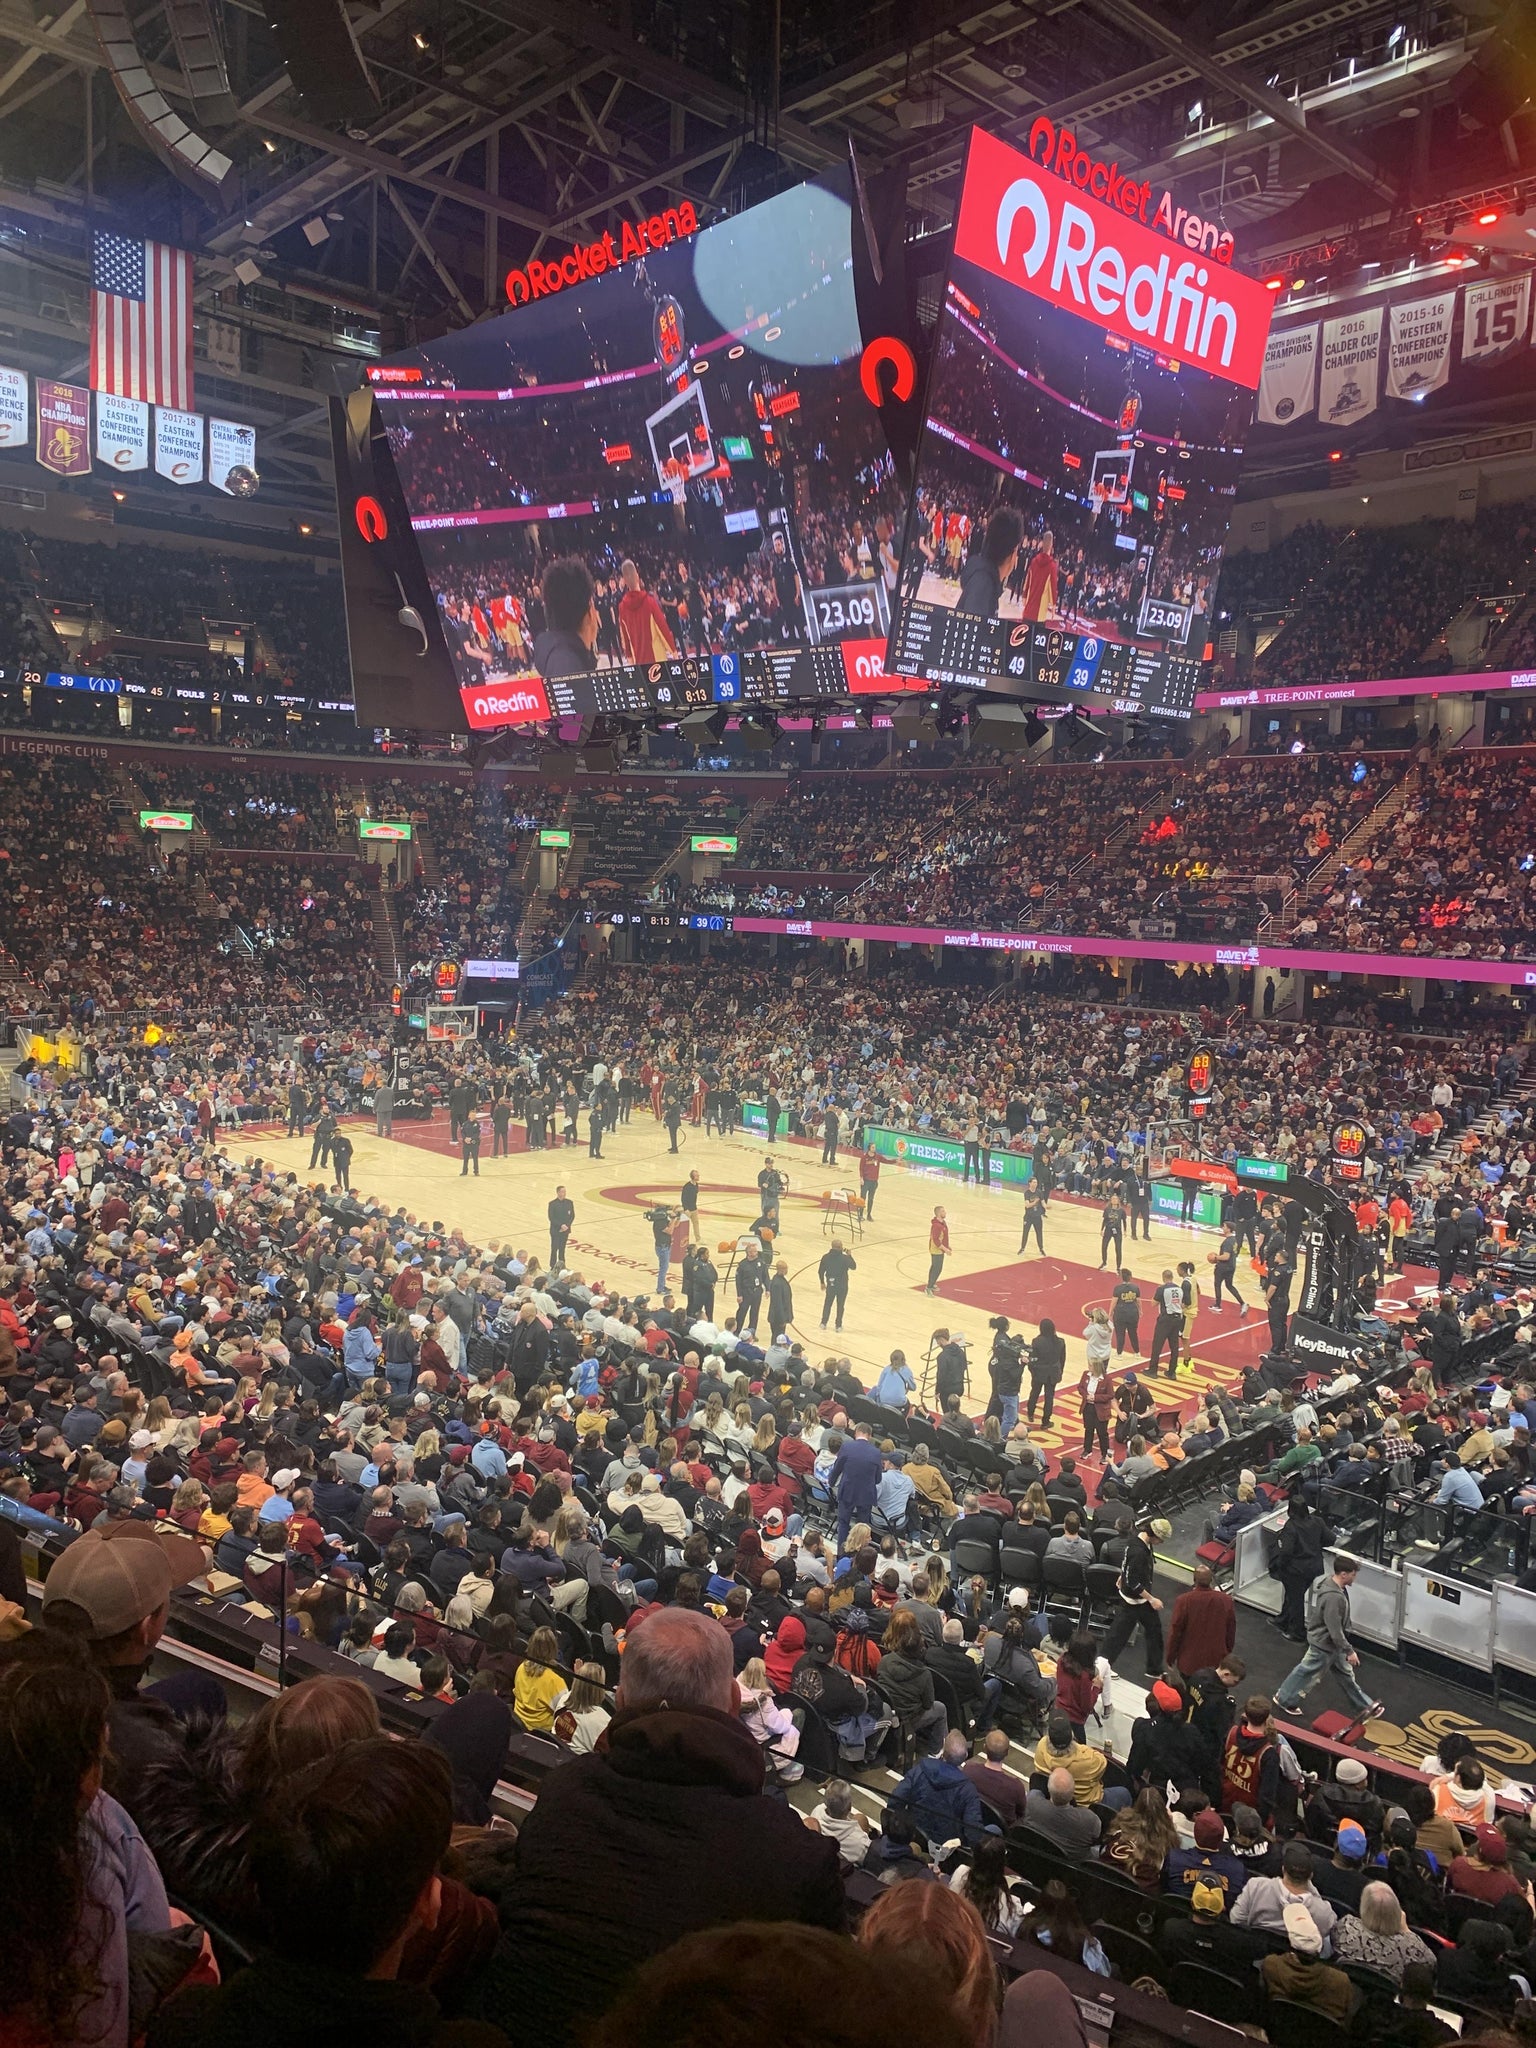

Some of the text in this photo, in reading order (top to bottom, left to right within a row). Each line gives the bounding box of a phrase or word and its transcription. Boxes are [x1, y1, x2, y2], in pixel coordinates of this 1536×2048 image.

[1055, 129, 1234, 265] Rocket Arena
[527, 200, 697, 298] Rocket Arena
[1051, 201, 1237, 367] Redfin
[1471, 283, 1525, 305] CALLANDER
[1400, 304, 1444, 324] 2015-16
[1340, 320, 1365, 336] 2016
[1400, 320, 1442, 340] WESTERN
[1473, 301, 1518, 348] 15
[1268, 333, 1311, 350] NORTH DIVISION
[1325, 332, 1379, 355] CALDER CUP
[1391, 333, 1448, 355] CONFERENCE
[1265, 342, 1313, 362] CHAMPIONS
[1325, 347, 1377, 370] CHAMPIONS
[1392, 348, 1444, 368] CHAMPIONS
[54, 400, 72, 413] NBA
[105, 396, 140, 412] 2016-17
[41, 407, 86, 426] CHAMPIONS
[107, 409, 139, 424] EASTERN
[162, 411, 196, 427] 2017-18
[99, 419, 145, 437] CONFERENCE
[163, 424, 195, 439] EASTERN
[211, 423, 232, 434] CENTRAL
[101, 430, 143, 447] CHAMPIONS
[158, 433, 200, 450] CONFERENCE
[213, 430, 252, 446] CHAMPIONS
[160, 444, 199, 460] CHAMPIONS
[819, 597, 875, 629] 23.09
[911, 602, 934, 612] CAVALIERS
[987, 617, 1000, 626] FOULS
[1150, 607, 1183, 629] 23.09
[908, 621, 932, 632] SCHRODER
[910, 612, 995, 635] BRYANT 2
[906, 632, 923, 642] PORTER
[1034, 634, 1047, 647] 2Q
[1063, 640, 1074, 651] 24
[903, 650, 925, 662] MITCHELL
[1112, 651, 1117, 659] 2
[670, 665, 682, 675] 2Q
[700, 662, 710, 672] 24
[1008, 655, 1025, 675] 49
[896, 662, 919, 675] oswald
[954, 673, 987, 688] RAFFLE
[1038, 668, 1060, 684] 8:13
[1073, 668, 1089, 686] 39
[1132, 673, 1150, 683] COOPER
[24, 672, 41, 684] 2Q
[59, 675, 74, 687] 39
[125, 684, 146, 694] FG%
[150, 687, 164, 697] 45
[176, 689, 205, 700] FOULS
[213, 691, 220, 701] 2
[232, 694, 250, 703] TOL
[256, 695, 263, 705] 6
[318, 701, 335, 710] LET
[657, 686, 672, 702] 49
[685, 689, 708, 703] 8:13
[719, 682, 734, 698] 39
[1220, 689, 1355, 706] DAVEY TREE-POINT contest
[487, 691, 540, 715] Redfin
[1114, 701, 1139, 713] $8,007
[11, 741, 109, 759] LEGENDS CLUB
[616, 828, 646, 838] Cleaning
[604, 844, 643, 852] Restoration
[585, 913, 733, 931] 2 49 2Q 8:13 24 39 2
[786, 923, 805, 933] DAVEY
[944, 935, 1073, 952] DAVEY TREE-POINT contest
[1216, 950, 1248, 960] DAVEY
[437, 972, 454, 986] 24
[1190, 1068, 1207, 1090] 24
[752, 1115, 768, 1126] DAVE
[909, 1143, 946, 1162] TREES
[1339, 1141, 1360, 1153] 24
[1246, 1166, 1269, 1176] DAVEY
[1159, 1197, 1184, 1210] DAVE
[1305, 1246, 1321, 1310] Cleveland Clinic
[1294, 1334, 1351, 1360] KeyBank
[374, 1577, 388, 1592] ELLIS
